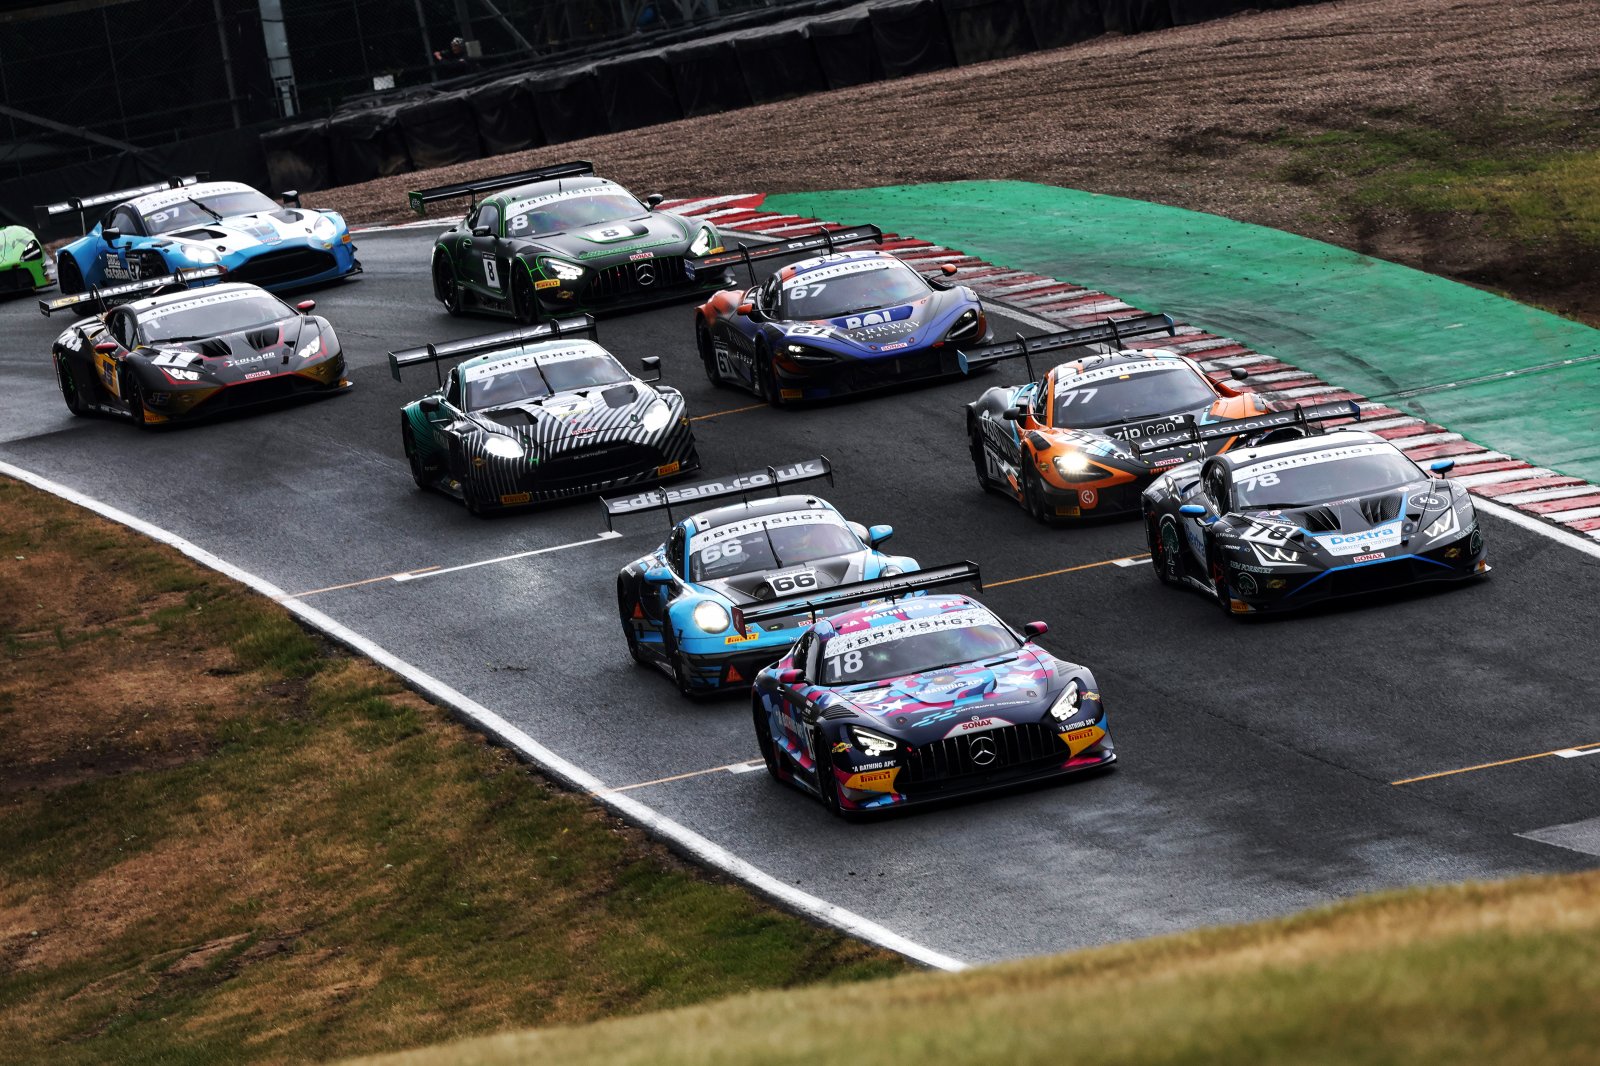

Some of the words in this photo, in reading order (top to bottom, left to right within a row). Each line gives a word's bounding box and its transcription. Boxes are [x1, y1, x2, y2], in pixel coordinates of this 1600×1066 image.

[151, 207, 179, 223] 97
[511, 214, 528, 230] 8
[601, 229, 619, 238] 8
[487, 261, 495, 281] 8
[536, 280, 559, 288] PIRELLI
[790, 283, 826, 300] 67
[147, 320, 161, 329] 1
[844, 321, 920, 340] PARKWAY
[862, 328, 911, 341] ENGLAND
[169, 352, 181, 363] 1
[480, 350, 587, 374] #BRITSHGT
[246, 371, 270, 379] SONAX
[477, 376, 495, 390] 7
[1060, 388, 1098, 408] 77
[560, 403, 578, 411] 7
[1155, 458, 1183, 466] SONAX
[612, 463, 817, 511] sdteam.couk
[1237, 472, 1281, 492] 78
[1250, 523, 1293, 541] 78
[1330, 528, 1394, 545] Dextra
[701, 541, 743, 564] 66
[1355, 553, 1384, 563] SONAX
[772, 573, 816, 592] 66
[847, 618, 977, 650] #BRITISHGT
[828, 650, 864, 679] 18
[962, 718, 993, 731] SONAX
[1068, 728, 1094, 741] PIRELLI
[859, 761, 883, 772] BATHING
[859, 771, 891, 784] PIRELLI
